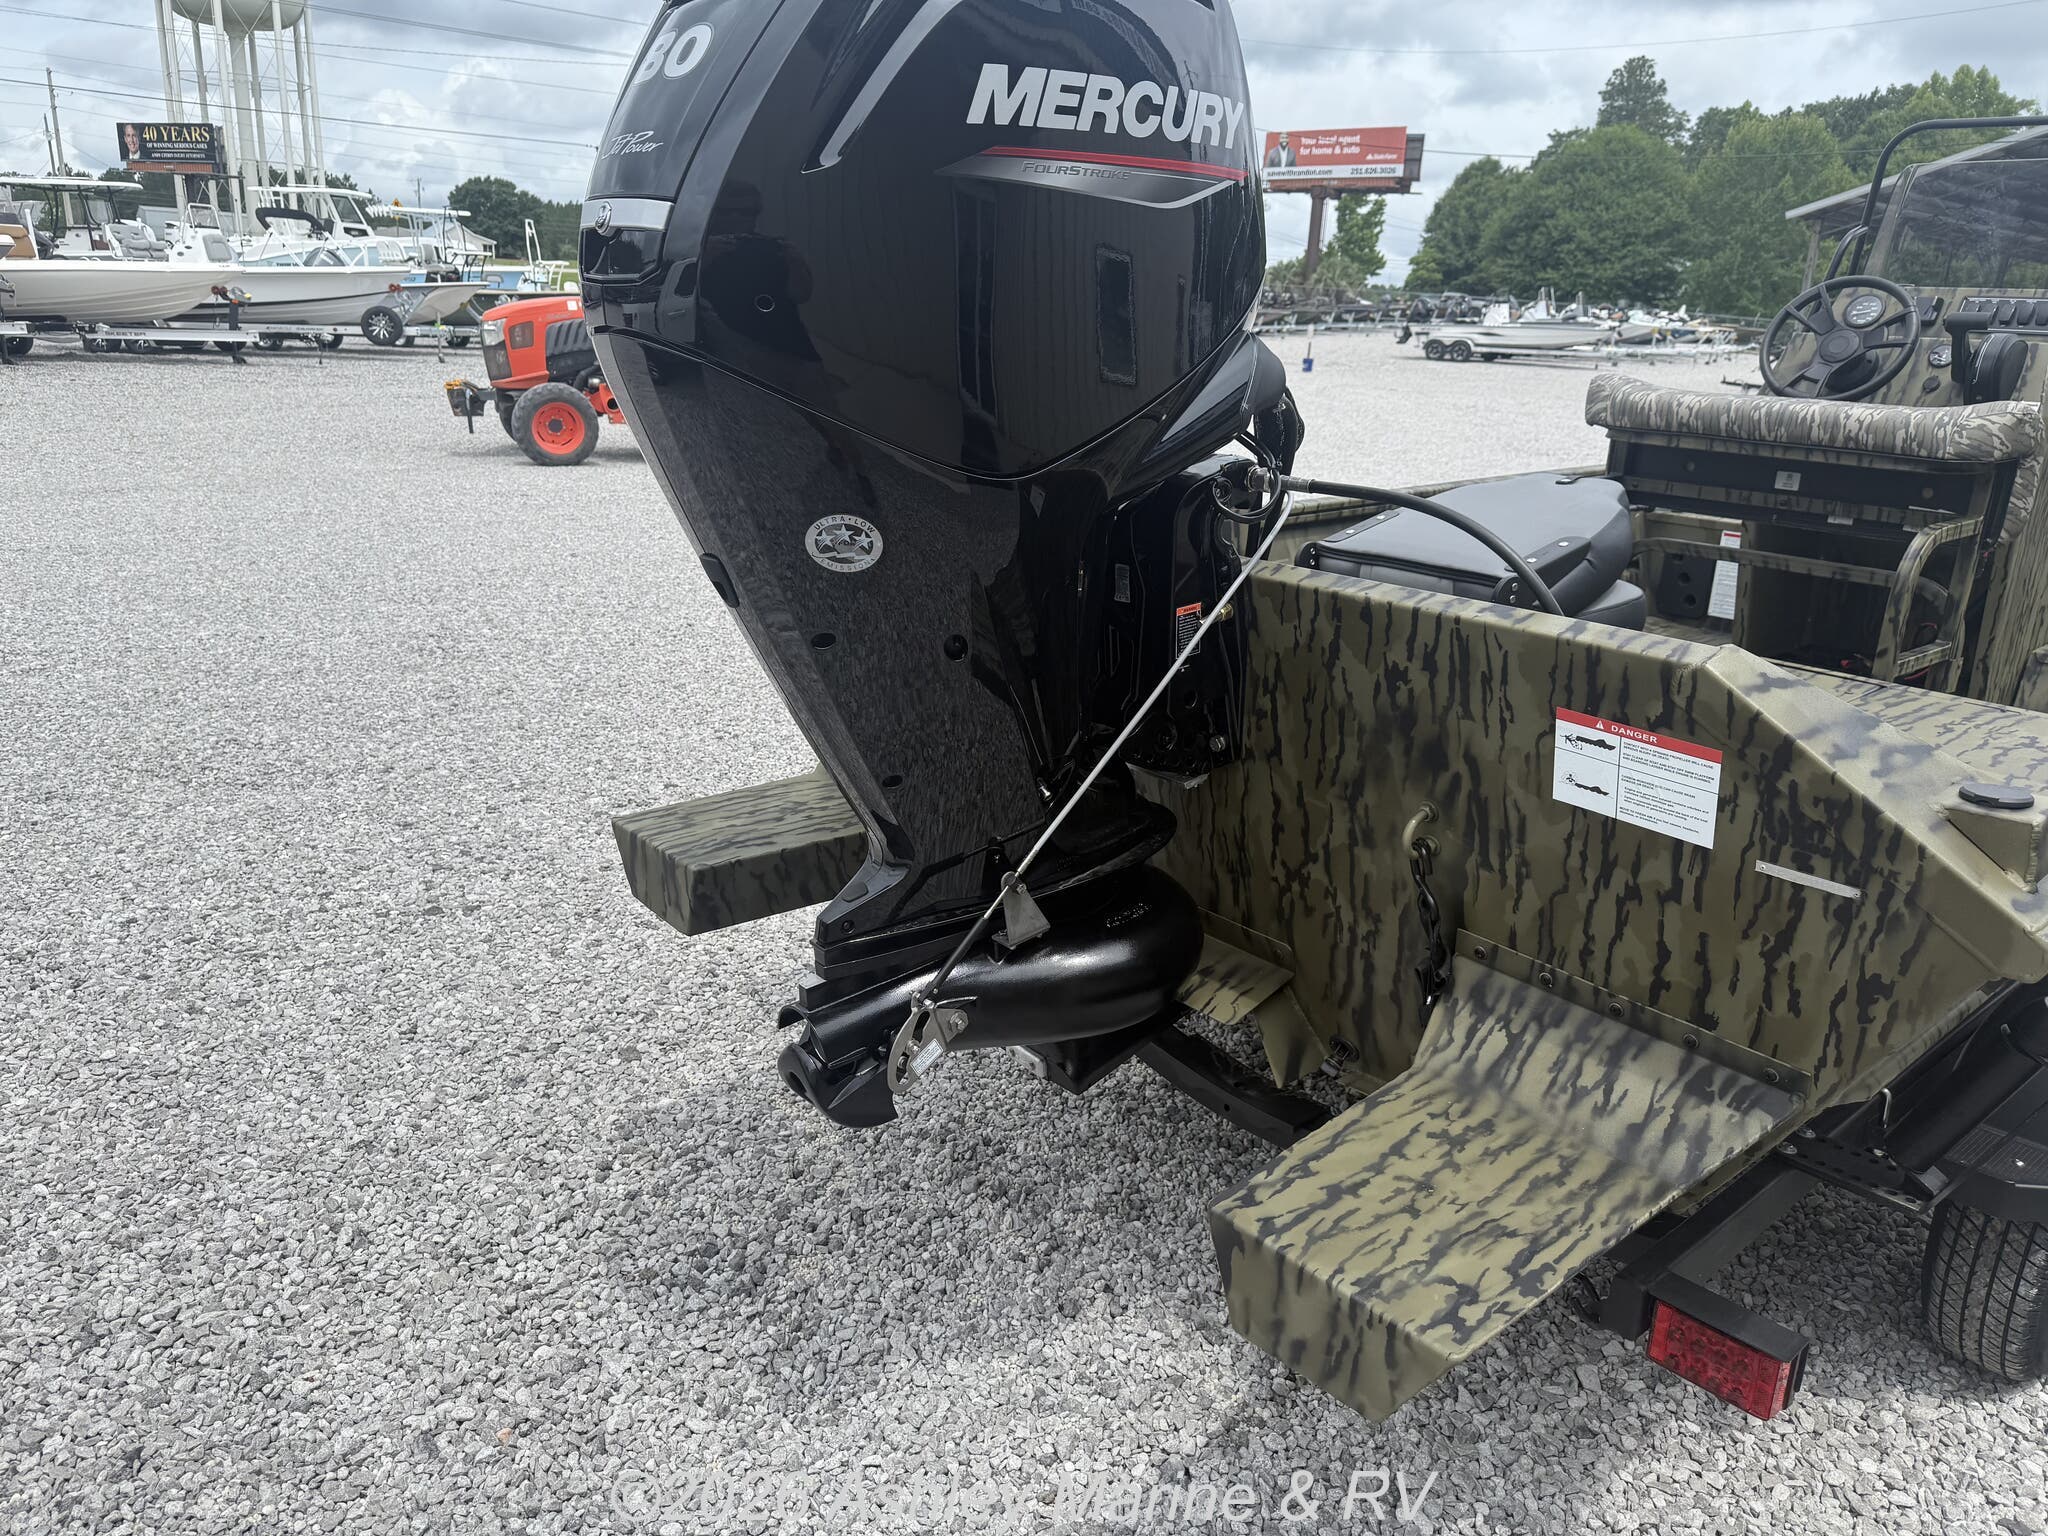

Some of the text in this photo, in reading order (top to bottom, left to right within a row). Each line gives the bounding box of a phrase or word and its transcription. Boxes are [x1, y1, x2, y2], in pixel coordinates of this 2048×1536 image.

[966, 62, 1244, 149] MERCURY
[143, 126, 210, 142] 40 YEARS
[621, 131, 664, 155] Power
[1300, 145, 1360, 155] for home & auto
[813, 516, 876, 533] ULTRA LOW
[1611, 725, 1658, 744] DANGER
